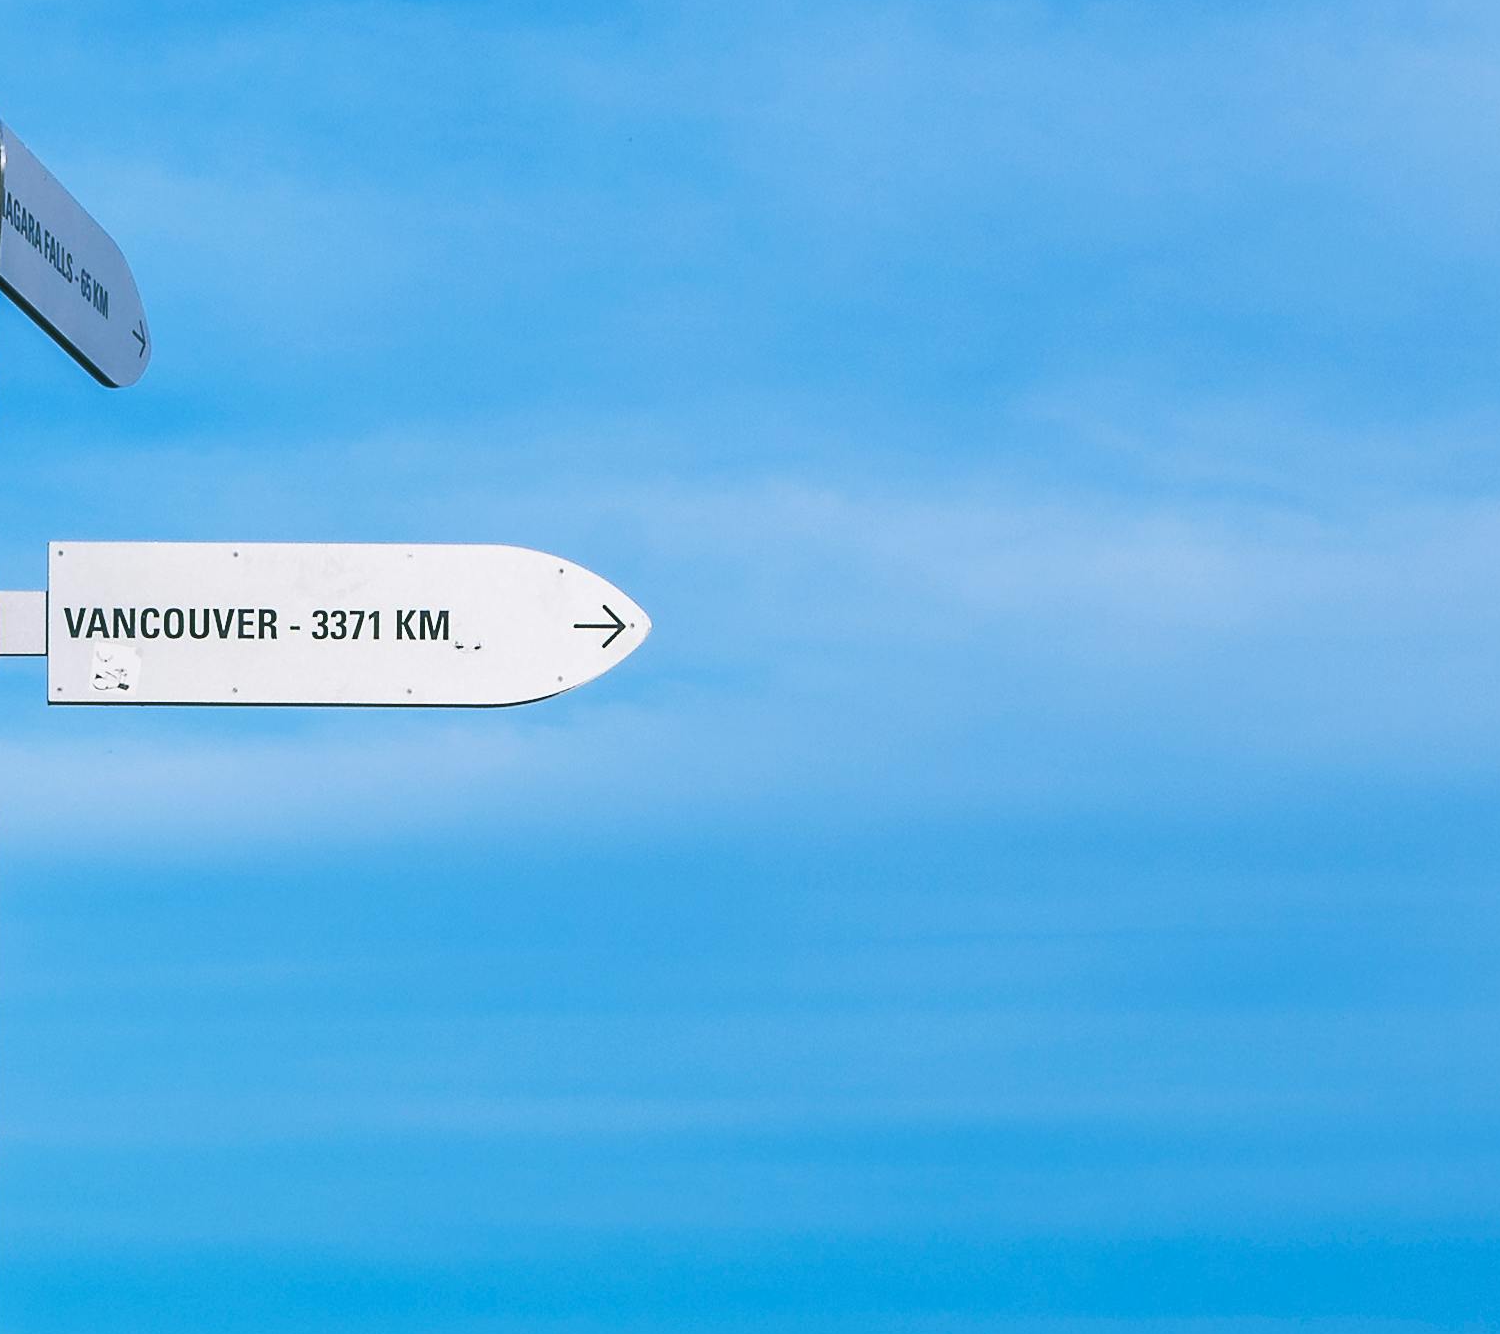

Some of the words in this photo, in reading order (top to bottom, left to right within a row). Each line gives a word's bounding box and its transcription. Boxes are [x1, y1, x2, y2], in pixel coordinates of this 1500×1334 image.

[1, 187, 42, 254] IAGARA
[43, 228, 74, 284] FALLS
[80, 268, 92, 303] 65
[93, 278, 109, 320] KM
[62, 606, 279, 641] VANCOUVER
[310, 609, 381, 641] 3371
[395, 608, 451, 642] KM
